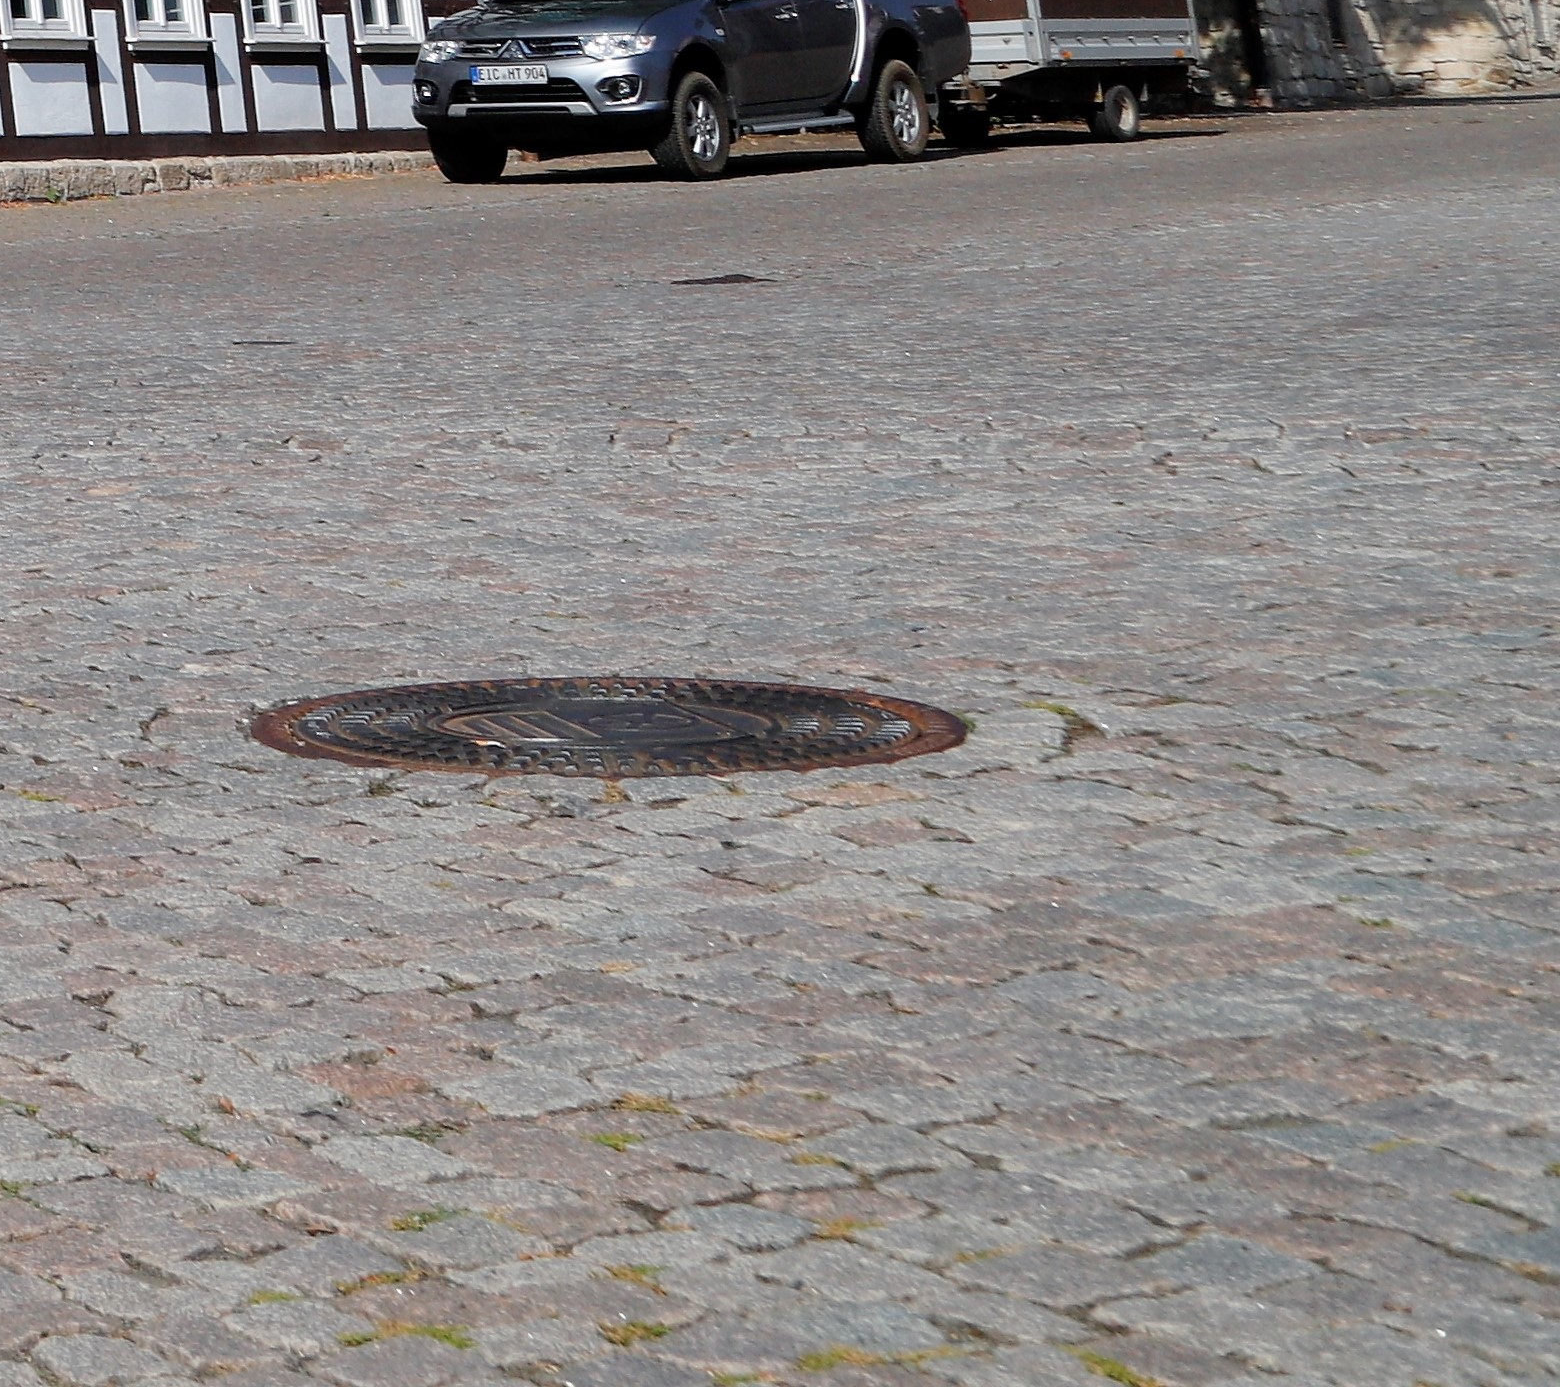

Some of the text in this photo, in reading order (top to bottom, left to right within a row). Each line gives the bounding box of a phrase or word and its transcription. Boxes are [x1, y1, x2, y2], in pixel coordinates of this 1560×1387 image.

[479, 68, 545, 80] EIC HT 904
